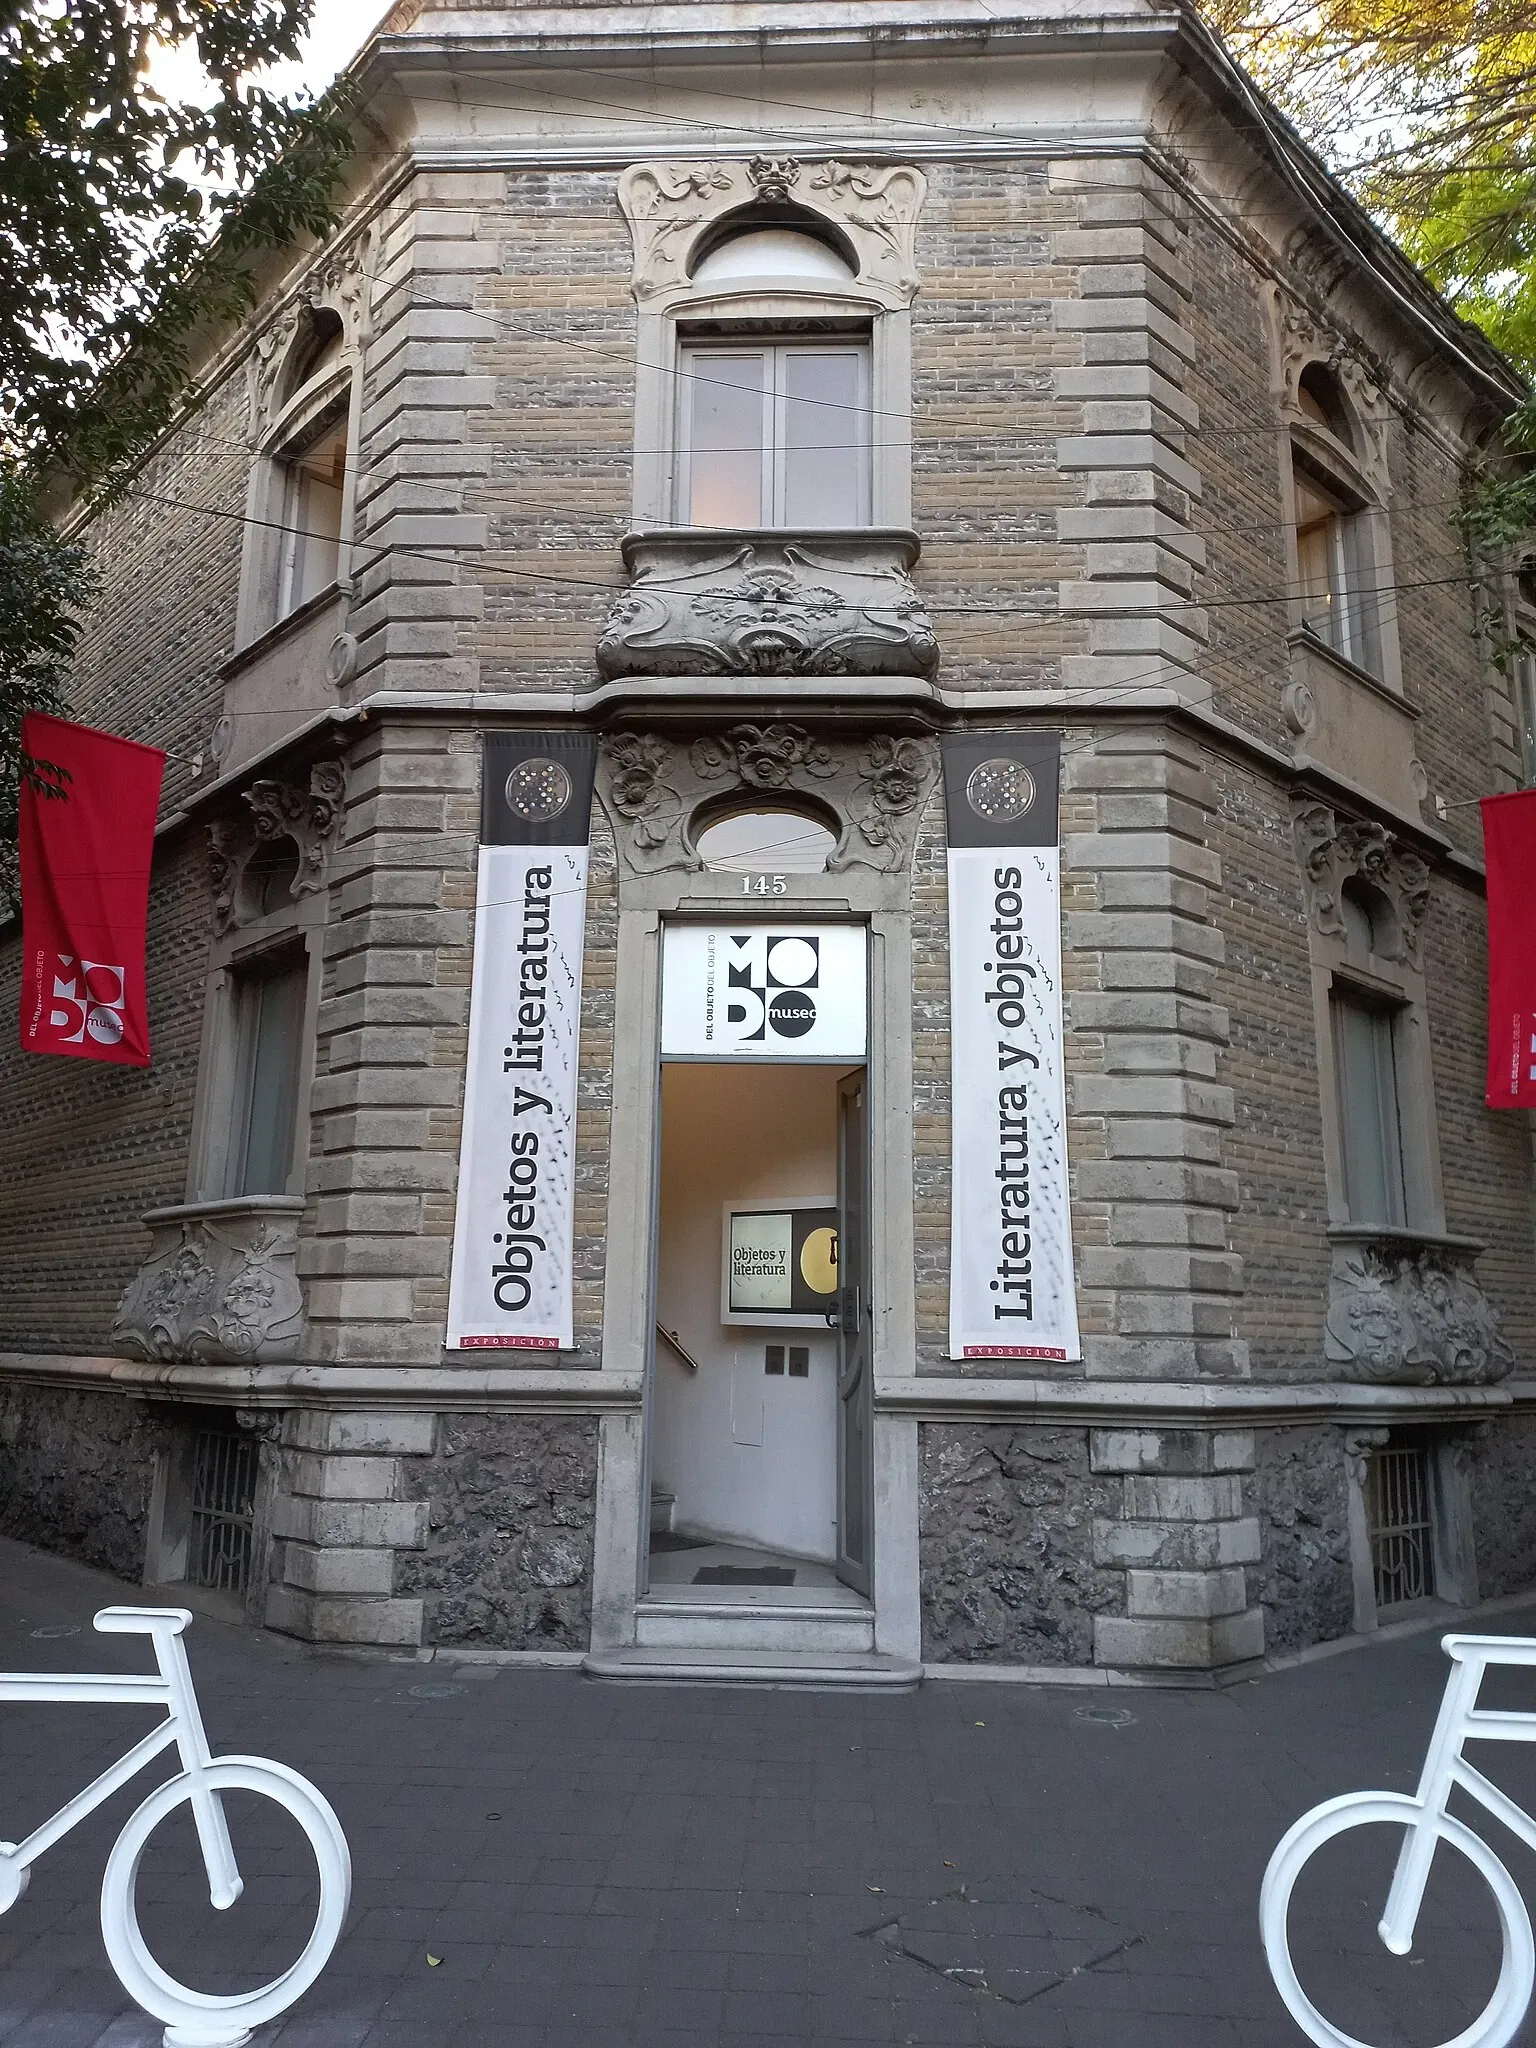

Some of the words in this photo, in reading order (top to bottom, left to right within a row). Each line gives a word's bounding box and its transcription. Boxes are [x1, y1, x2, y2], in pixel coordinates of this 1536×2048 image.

[741, 875, 787, 895] 145
[707, 934, 716, 968] OBJETO
[984, 866, 1037, 1028] objetos
[36, 950, 44, 979] OBJETO
[503, 865, 552, 1073] literatura
[706, 970, 715, 986] DEL
[706, 986, 715, 1022] OBJETO
[768, 1007, 817, 1020] museo
[706, 1023, 714, 1041] DEL
[998, 1040, 1040, 1071] y
[513, 1086, 553, 1116] y
[989, 1084, 1033, 1321] Literatura
[492, 1131, 547, 1312] Objetos
[733, 1247, 776, 1265] Objetos
[778, 1250, 786, 1264] y
[733, 1261, 786, 1275] literatura
